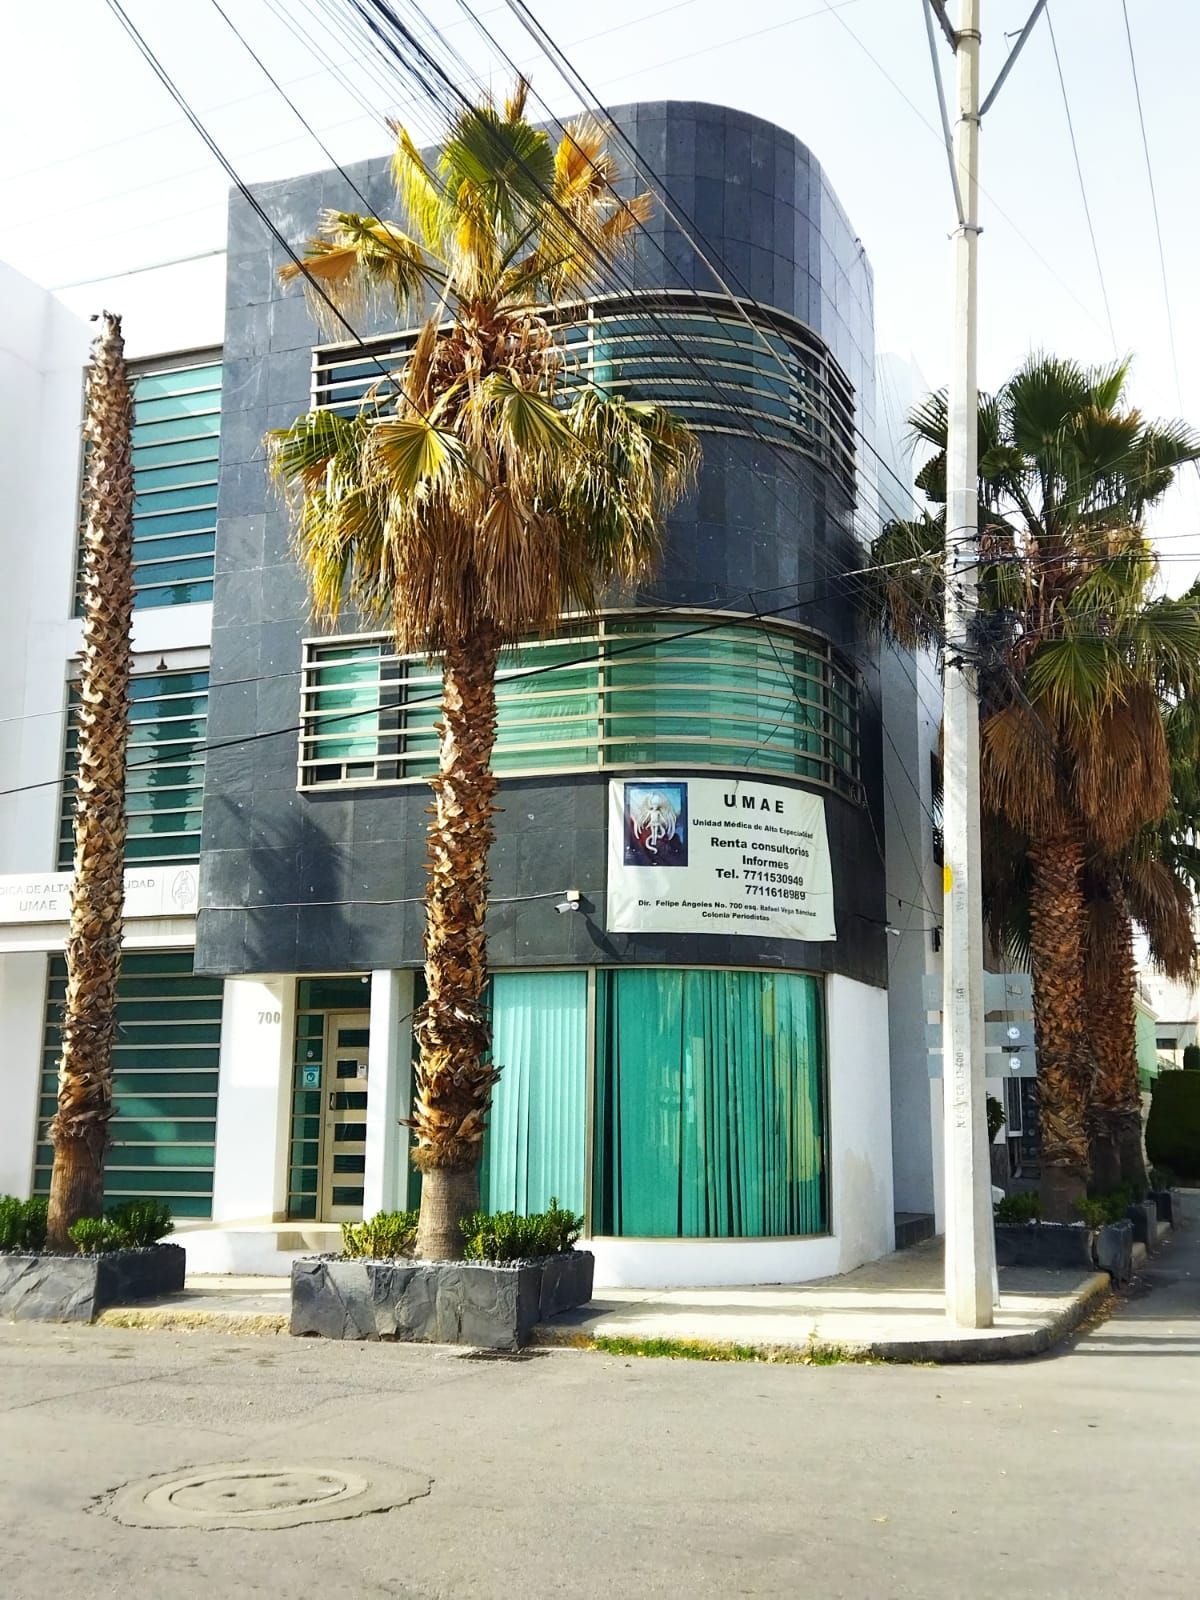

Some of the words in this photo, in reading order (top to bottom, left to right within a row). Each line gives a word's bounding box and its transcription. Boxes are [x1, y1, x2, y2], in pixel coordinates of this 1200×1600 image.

[692, 819, 722, 827] Unidad
[753, 823, 764, 831] de
[764, 825, 779, 833] Alta
[710, 837, 748, 849] Renta
[751, 842, 810, 858] consultorios
[742, 855, 789, 870] Informes
[715, 868, 740, 879] Tel.
[743, 869, 804, 887] 7711530949
[26, 884, 41, 895] DE
[19, 899, 57, 912] UMAE
[638, 899, 652, 907] Dir.
[655, 899, 680, 908] Felipe
[714, 901, 728, 909] No.
[729, 902, 743, 910] 700
[744, 903, 759, 911] esq.
[702, 911, 730, 919] Colonia
[731, 912, 770, 921] Periodistas
[257, 1011, 281, 1025] 700
